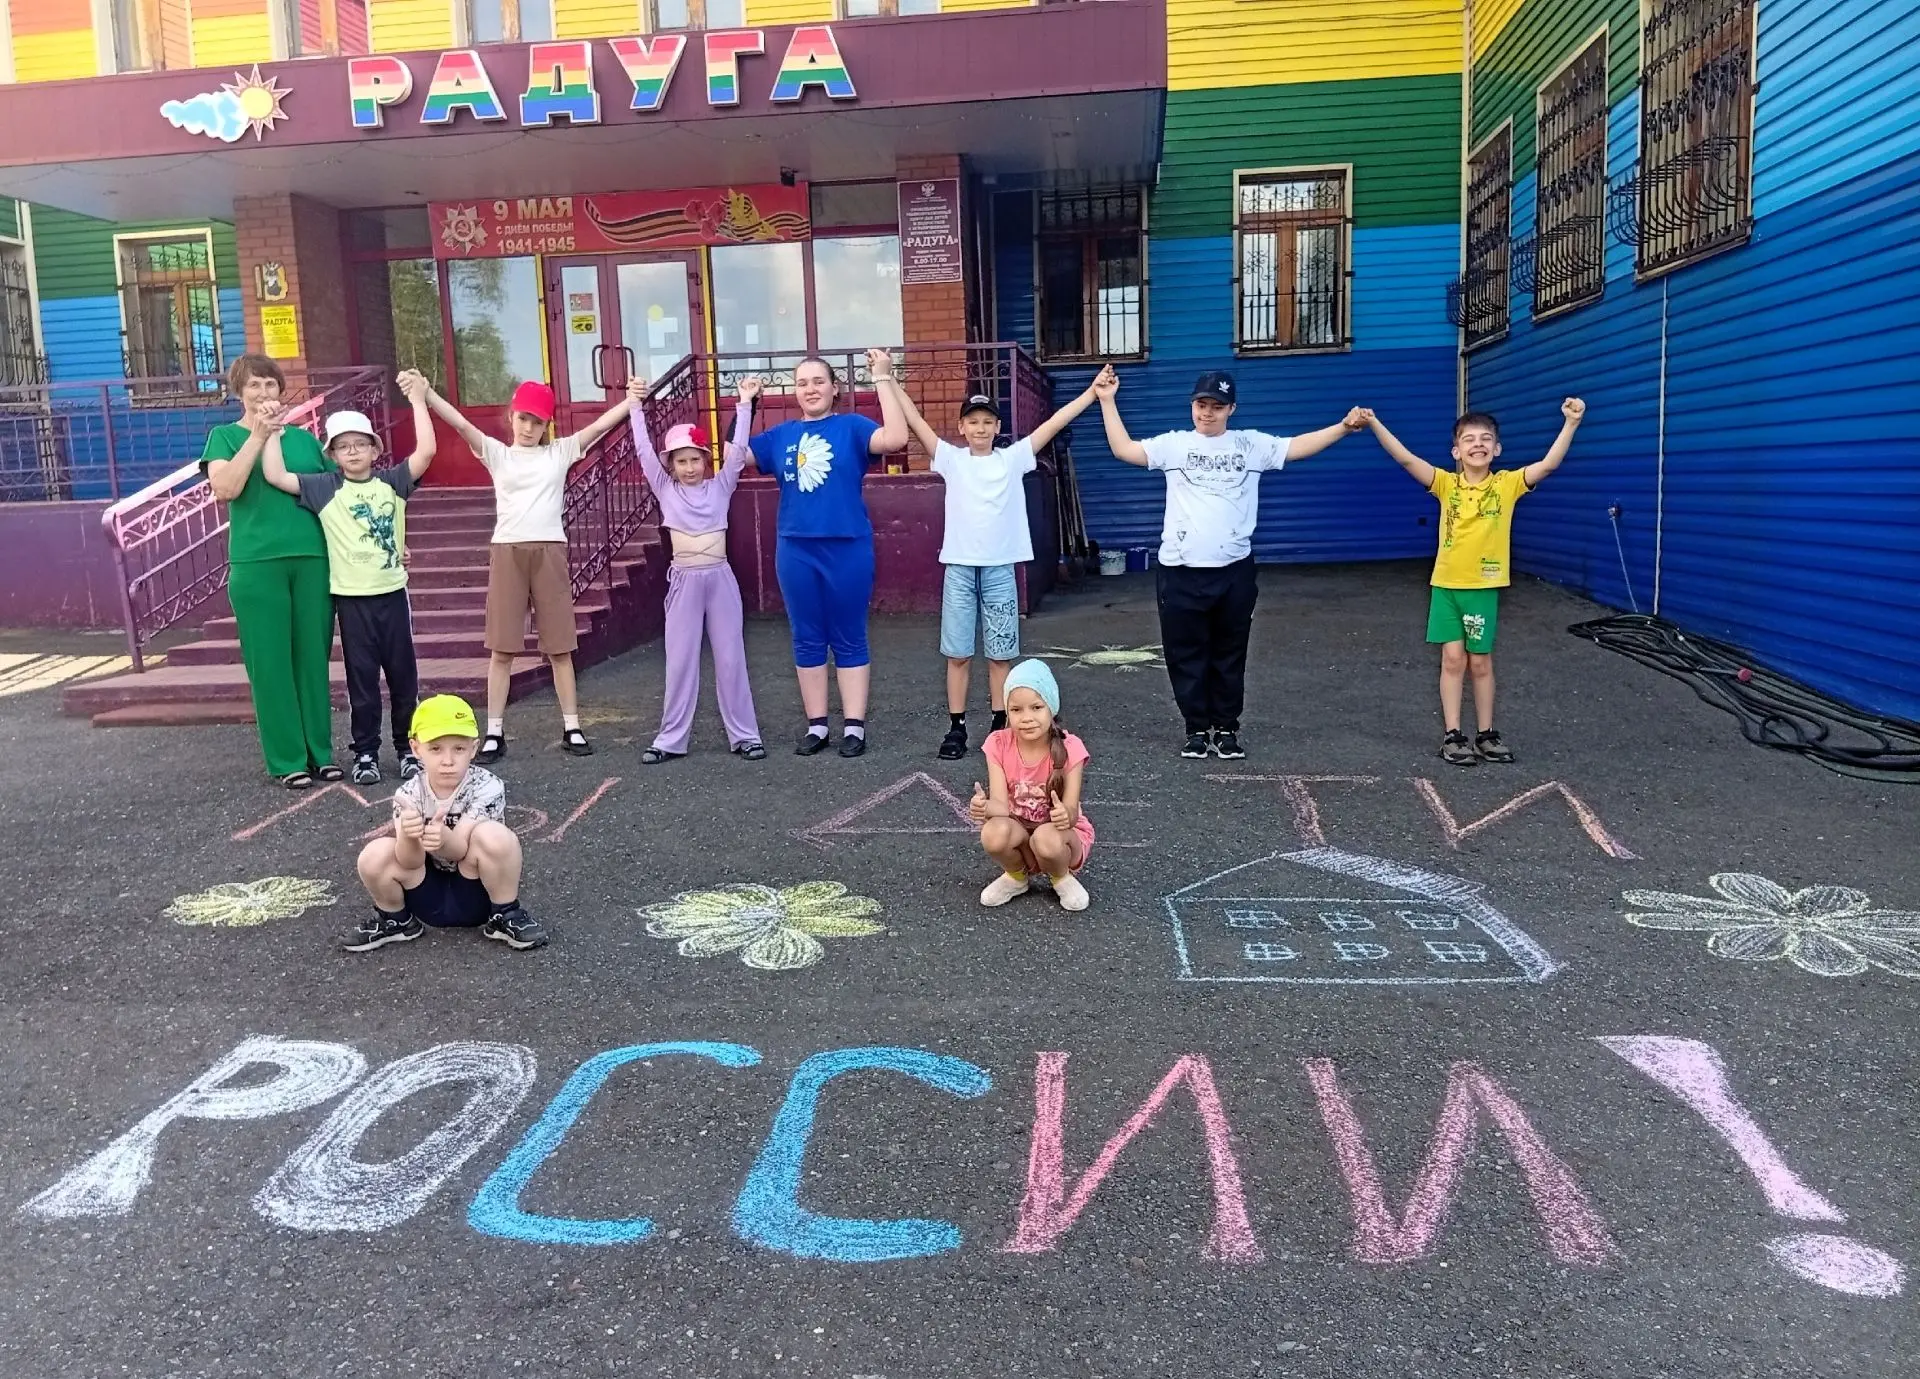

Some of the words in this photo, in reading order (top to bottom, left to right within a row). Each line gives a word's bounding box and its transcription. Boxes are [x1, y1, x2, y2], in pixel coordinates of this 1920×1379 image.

[346, 25, 857, 128] РАДУГА
[493, 200, 509, 221] 9
[517, 197, 574, 220] МАЯ
[496, 225, 503, 235] С
[504, 224, 531, 237] ДНЁМ
[497, 236, 576, 255] 1941-1945
[784, 471, 796, 482] be
[16, 1033, 1906, 1298] РОССИИ!
